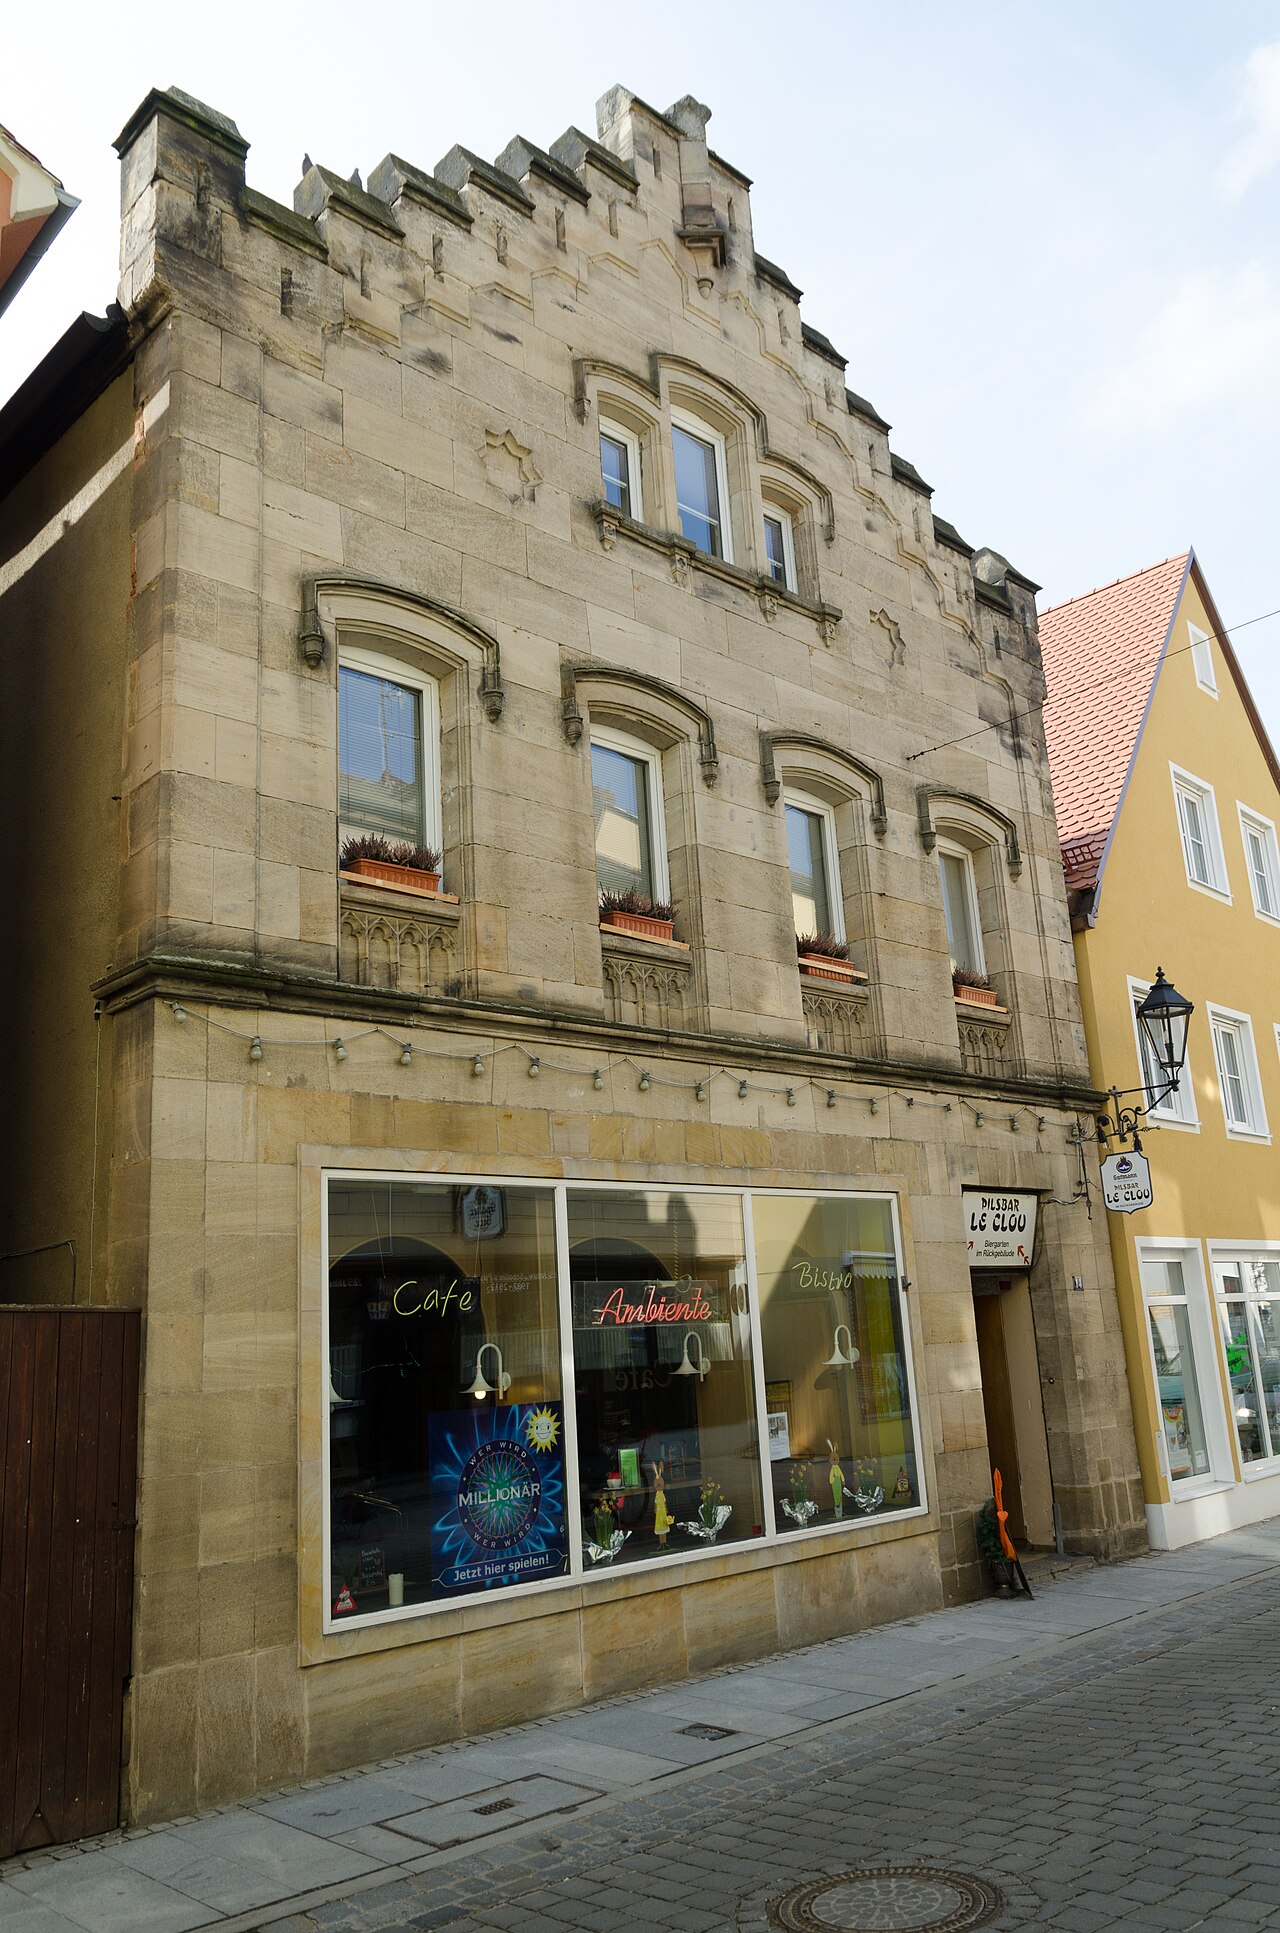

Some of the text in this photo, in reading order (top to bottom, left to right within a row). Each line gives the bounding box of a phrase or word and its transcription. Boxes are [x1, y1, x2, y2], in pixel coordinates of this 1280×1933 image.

[1107, 1189, 1149, 1203] LE CLOU
[1114, 1182, 1139, 1191] PILSBAR
[981, 1197, 1019, 1212] PILSBAR
[970, 1212, 1026, 1232] LE CLOU
[983, 1249, 1015, 1258] Rückgebäude
[984, 1240, 1009, 1249] Biergarten
[792, 1261, 852, 1290] Bistro
[598, 1285, 712, 1325] Ambiente
[469, 1441, 527, 1466] WER WIRD
[458, 1482, 541, 1507] MILLIONÄR
[473, 1523, 531, 1549] WER WIRD
[453, 1553, 550, 1582] Jetzt hier spielen!
